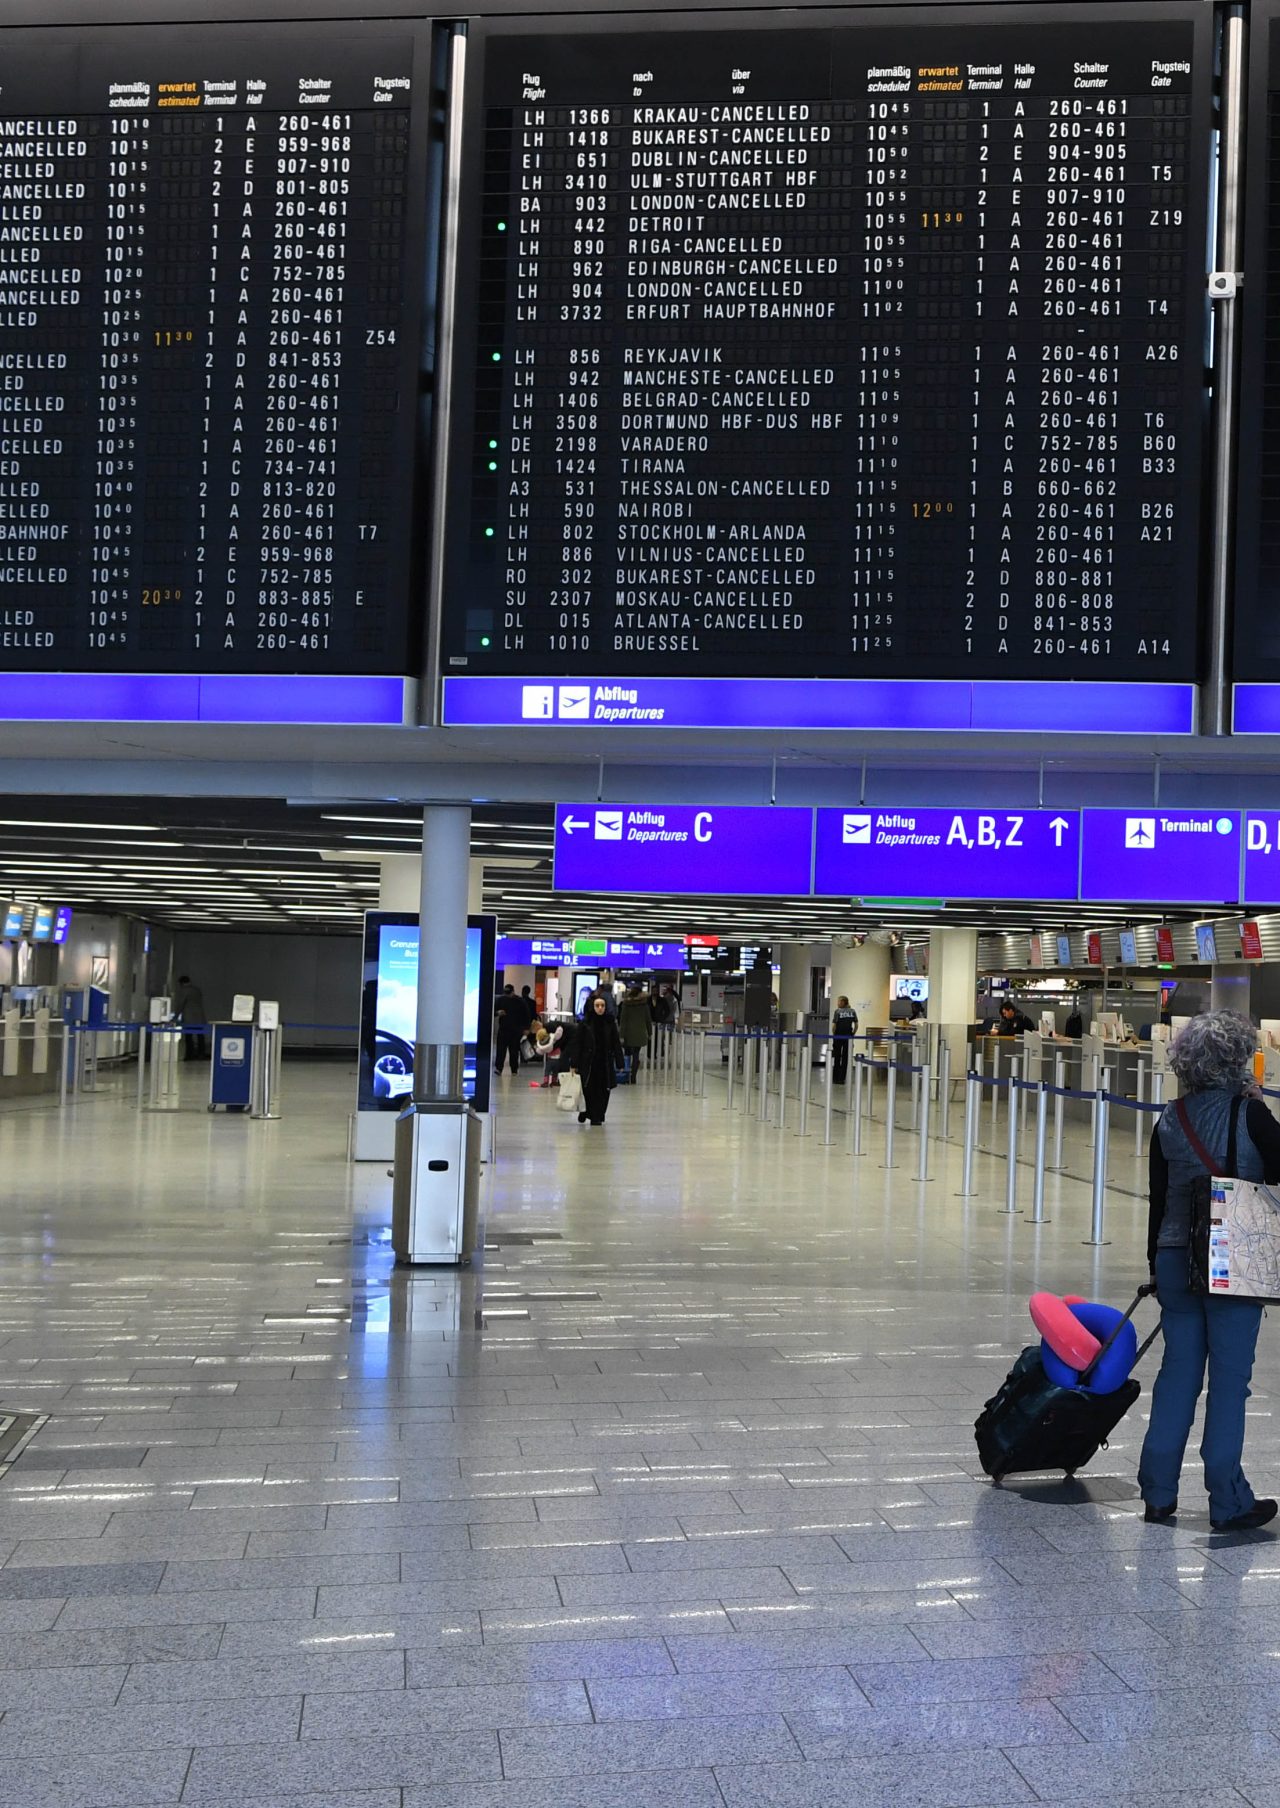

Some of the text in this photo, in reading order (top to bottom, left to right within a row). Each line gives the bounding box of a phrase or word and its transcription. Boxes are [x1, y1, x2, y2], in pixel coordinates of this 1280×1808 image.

[732, 69, 751, 79] über
[1074, 62, 1109, 73] Schalter
[1152, 61, 1190, 74] Flugsteig
[374, 77, 410, 90] Flugsteig
[633, 71, 653, 81] nach
[1074, 77, 1108, 88] Counter
[1151, 76, 1171, 86] Gate
[373, 91, 393, 102] Gate
[525, 105, 809, 125] LH 1366 KRAKAU-CANCELLED
[279, 136, 350, 152] 959-968
[631, 171, 817, 189] ULM-STUTTGART HBF
[520, 216, 704, 233] LH 442 DETROIT
[1047, 210, 1182, 226] 260-461 Z19
[628, 259, 837, 276] EDINBURGH-CANCELLED
[627, 303, 835, 319] ERFURT HAUPTBAHNHOF
[270, 330, 395, 345] 260-461 Z54
[625, 348, 721, 363] REYKJAVIK
[624, 369, 833, 385] MANCHESTE-CANCELLED
[512, 436, 707, 451] DE 2198 VARADERO
[1041, 435, 1175, 450] 752-785 B60
[621, 459, 685, 473] TIRANA
[619, 503, 691, 517] NAIROBI
[619, 525, 805, 540] STOCKHOLM-ARLANDA
[259, 591, 333, 605] 883-885
[616, 591, 792, 606] MOSKAU-CANCELLED
[614, 636, 699, 650] BRUESSEL
[594, 686, 638, 704] Abflug
[594, 704, 665, 722] Departures
[627, 812, 665, 828] Abflug
[694, 811, 713, 843] C
[876, 815, 916, 831] Abflug
[1160, 818, 1212, 833] Terminal
[627, 828, 688, 843] Departures
[875, 832, 940, 847] Departures
[839, 1011, 855, 1019] ZOLL
